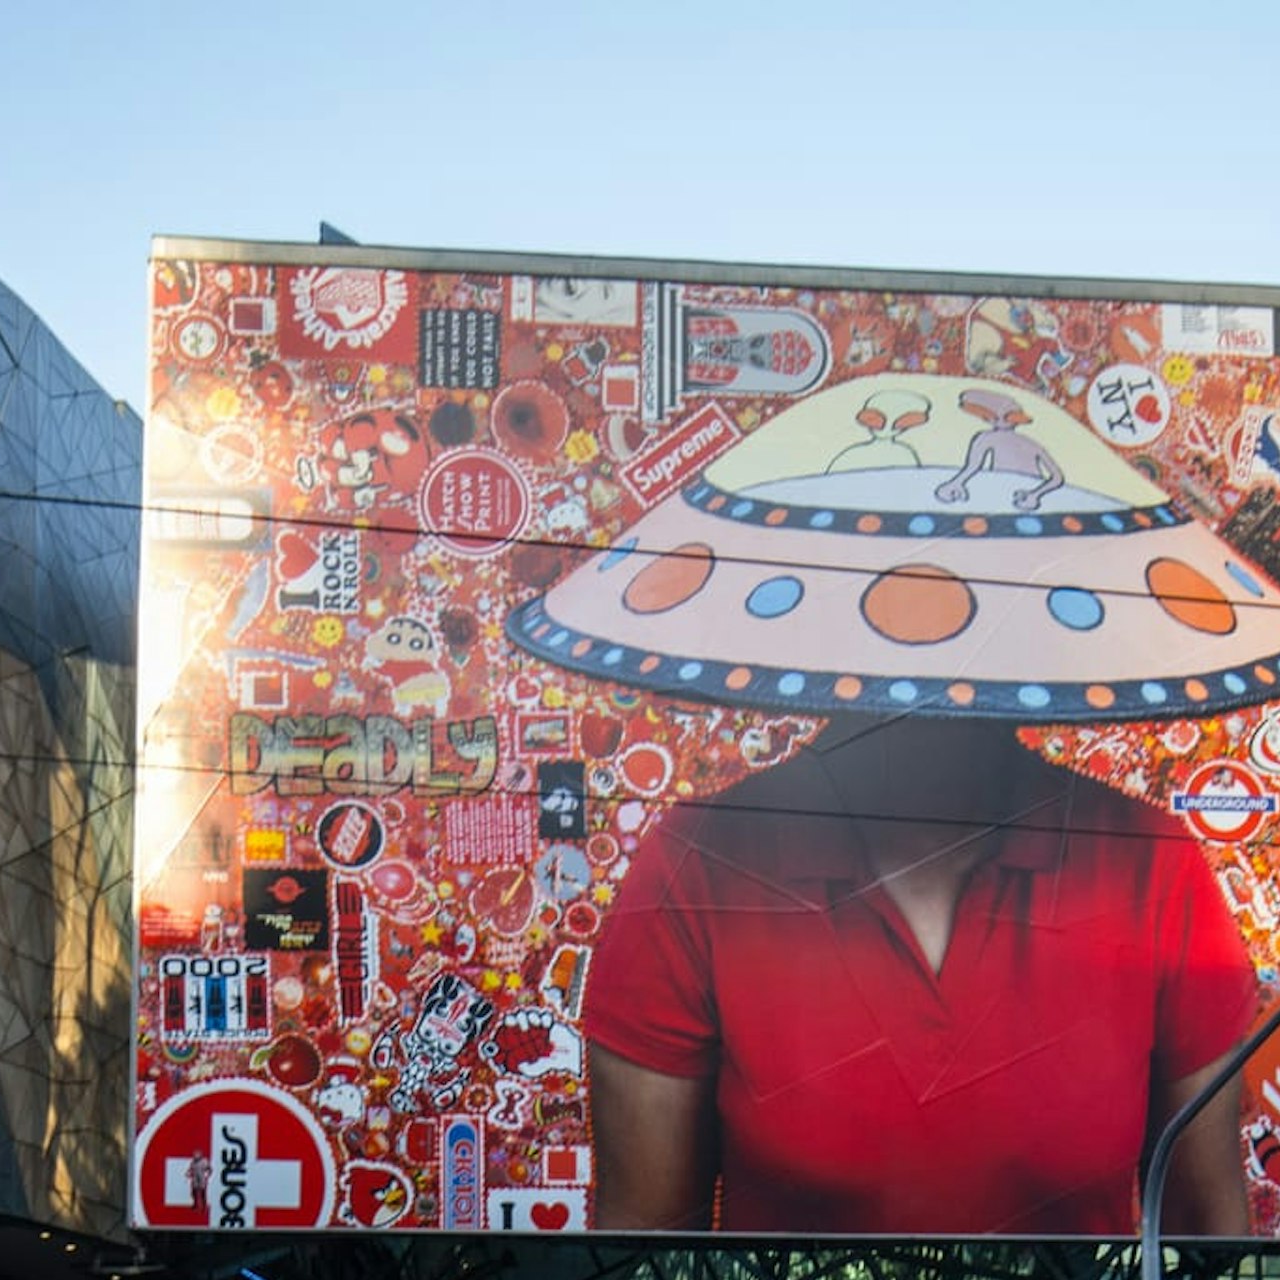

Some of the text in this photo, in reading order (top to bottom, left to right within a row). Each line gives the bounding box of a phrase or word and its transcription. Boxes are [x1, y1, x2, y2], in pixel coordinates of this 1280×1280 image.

[481, 355, 494, 388] NOT
[1096, 376, 1137, 435] NY
[632, 417, 724, 493] Supreme
[438, 471, 456, 533] HATCH
[457, 472, 474, 531] SHOW
[474, 471, 492, 532] PRINT
[323, 534, 342, 611] ROCK
[343, 535, 358, 589] ROLL
[1180, 796, 1269, 811] UNDERGROUND
